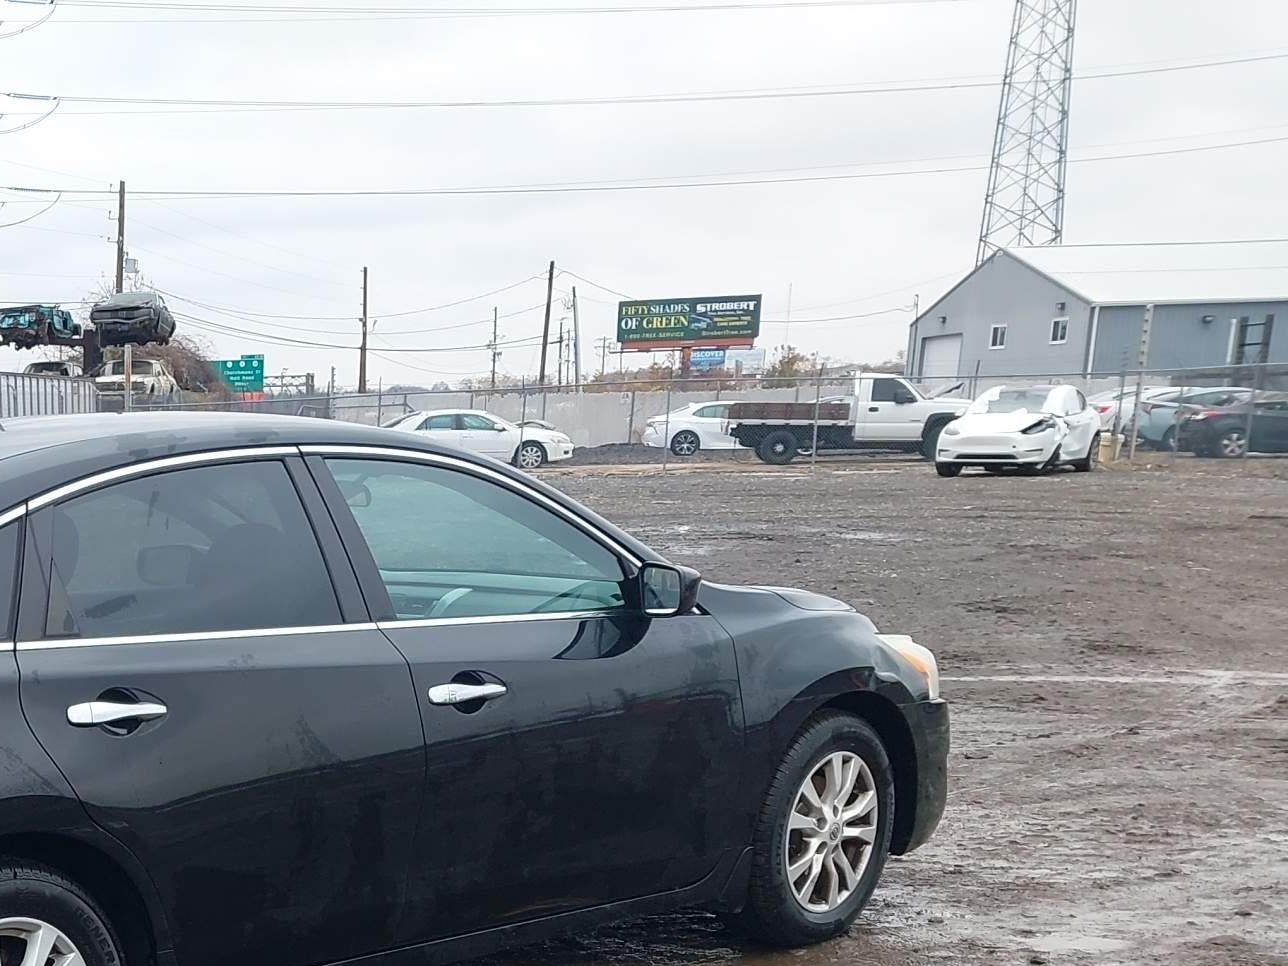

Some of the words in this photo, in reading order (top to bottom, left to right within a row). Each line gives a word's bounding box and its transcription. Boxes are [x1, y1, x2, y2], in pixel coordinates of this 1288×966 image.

[622, 305, 648, 315] FIFTY
[650, 303, 690, 314] SHADES
[696, 301, 757, 313] STROBERT
[621, 318, 640, 330] OF
[642, 315, 688, 329] GREEN
